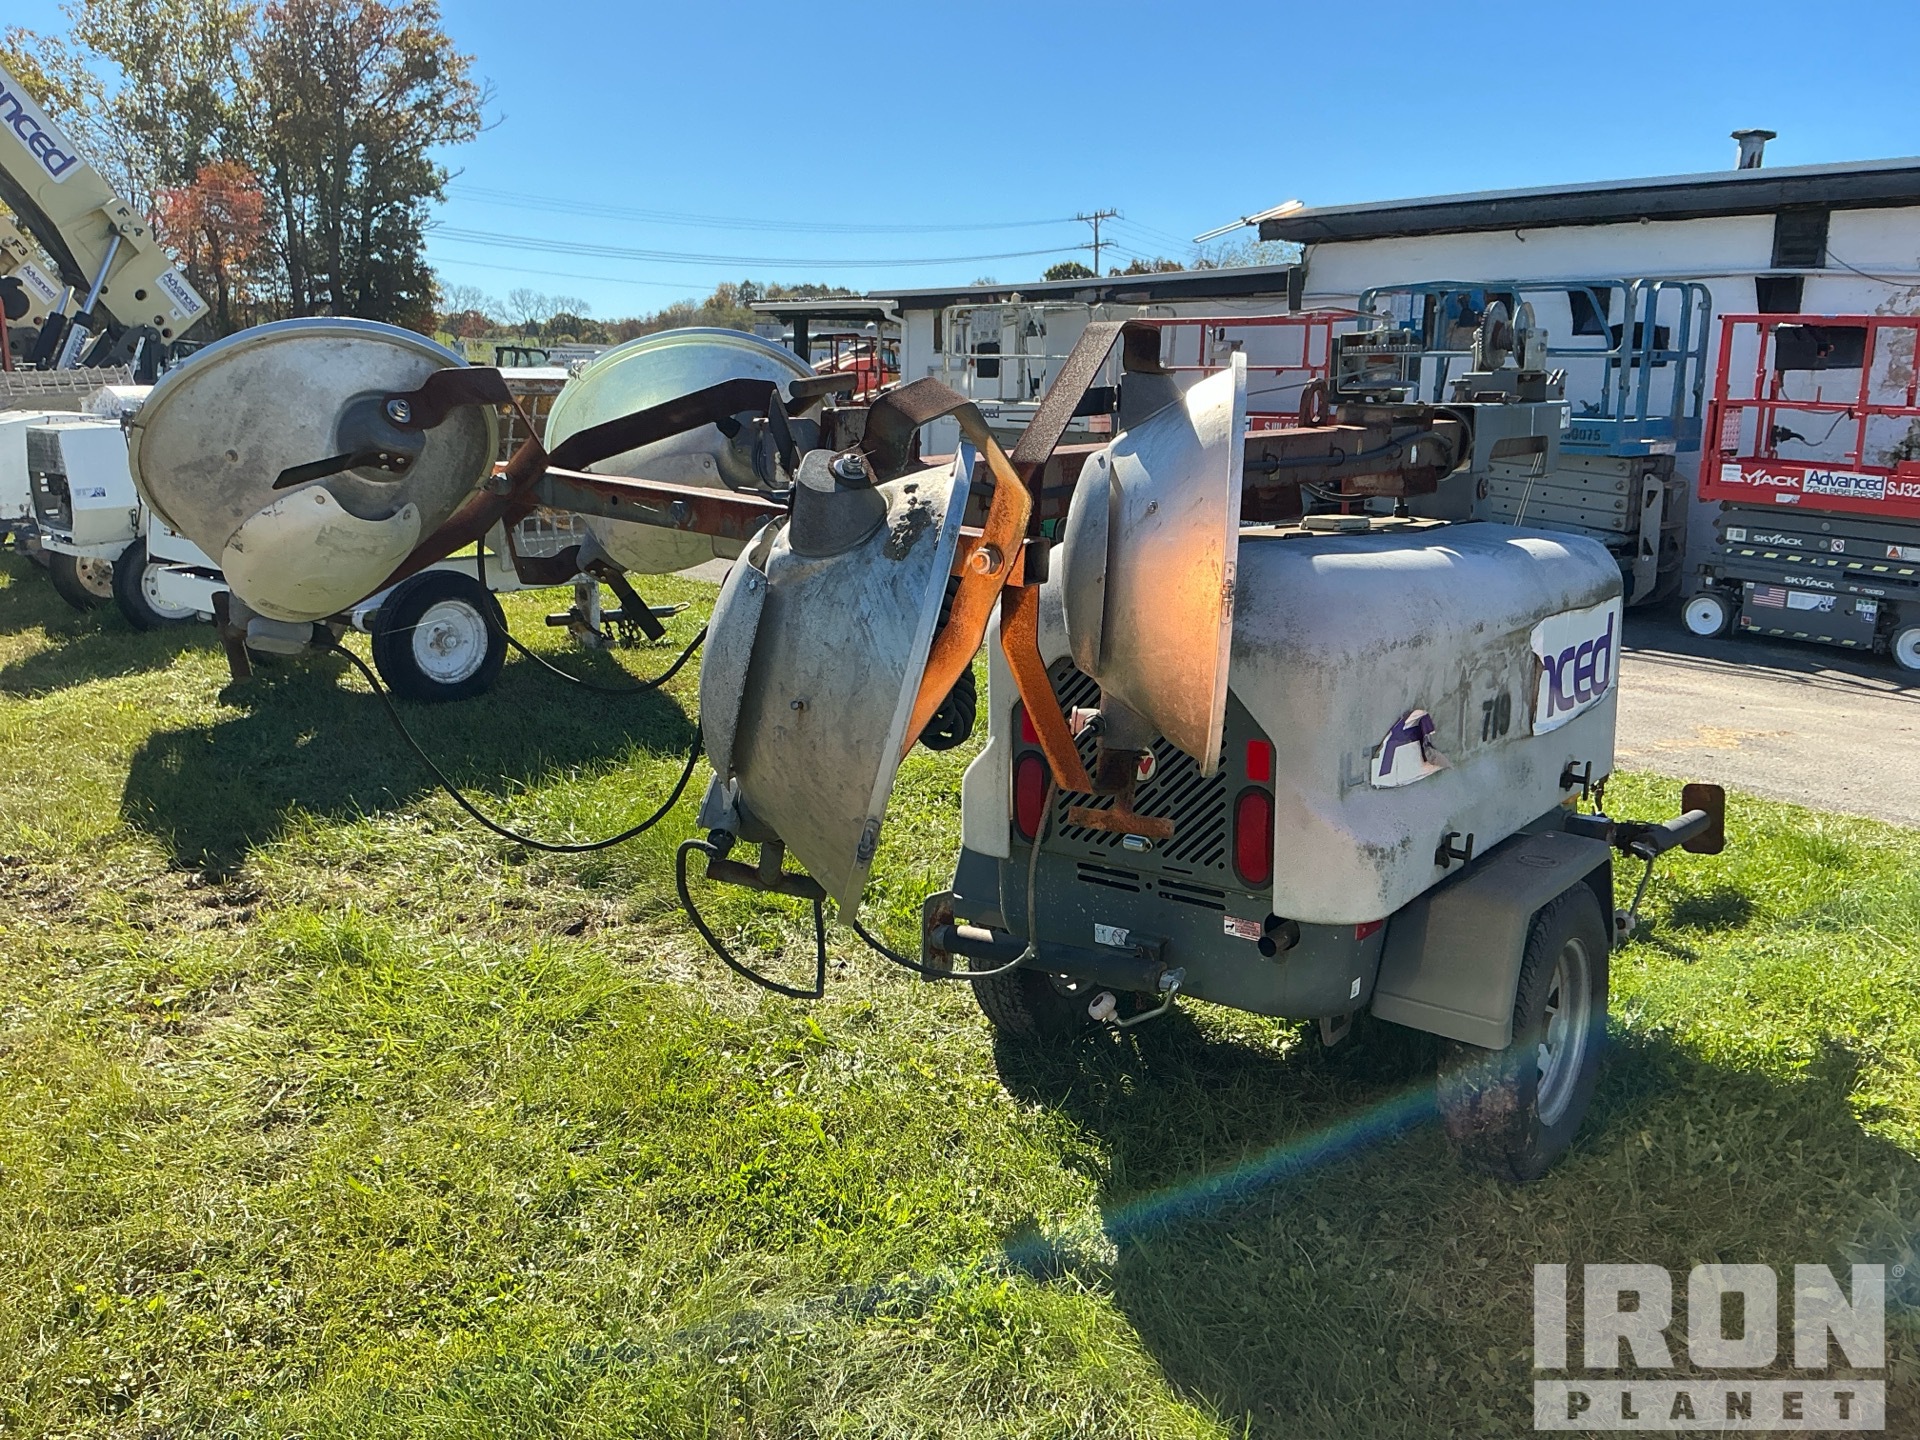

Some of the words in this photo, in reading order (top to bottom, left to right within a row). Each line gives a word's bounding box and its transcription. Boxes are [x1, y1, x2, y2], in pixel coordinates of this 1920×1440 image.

[0, 81, 78, 177] nced
[164, 272, 200, 312] Advanced
[1807, 470, 1885, 491] Advanced
[1753, 534, 1803, 546] SKYJACK
[1784, 576, 1834, 589] SKYJACK
